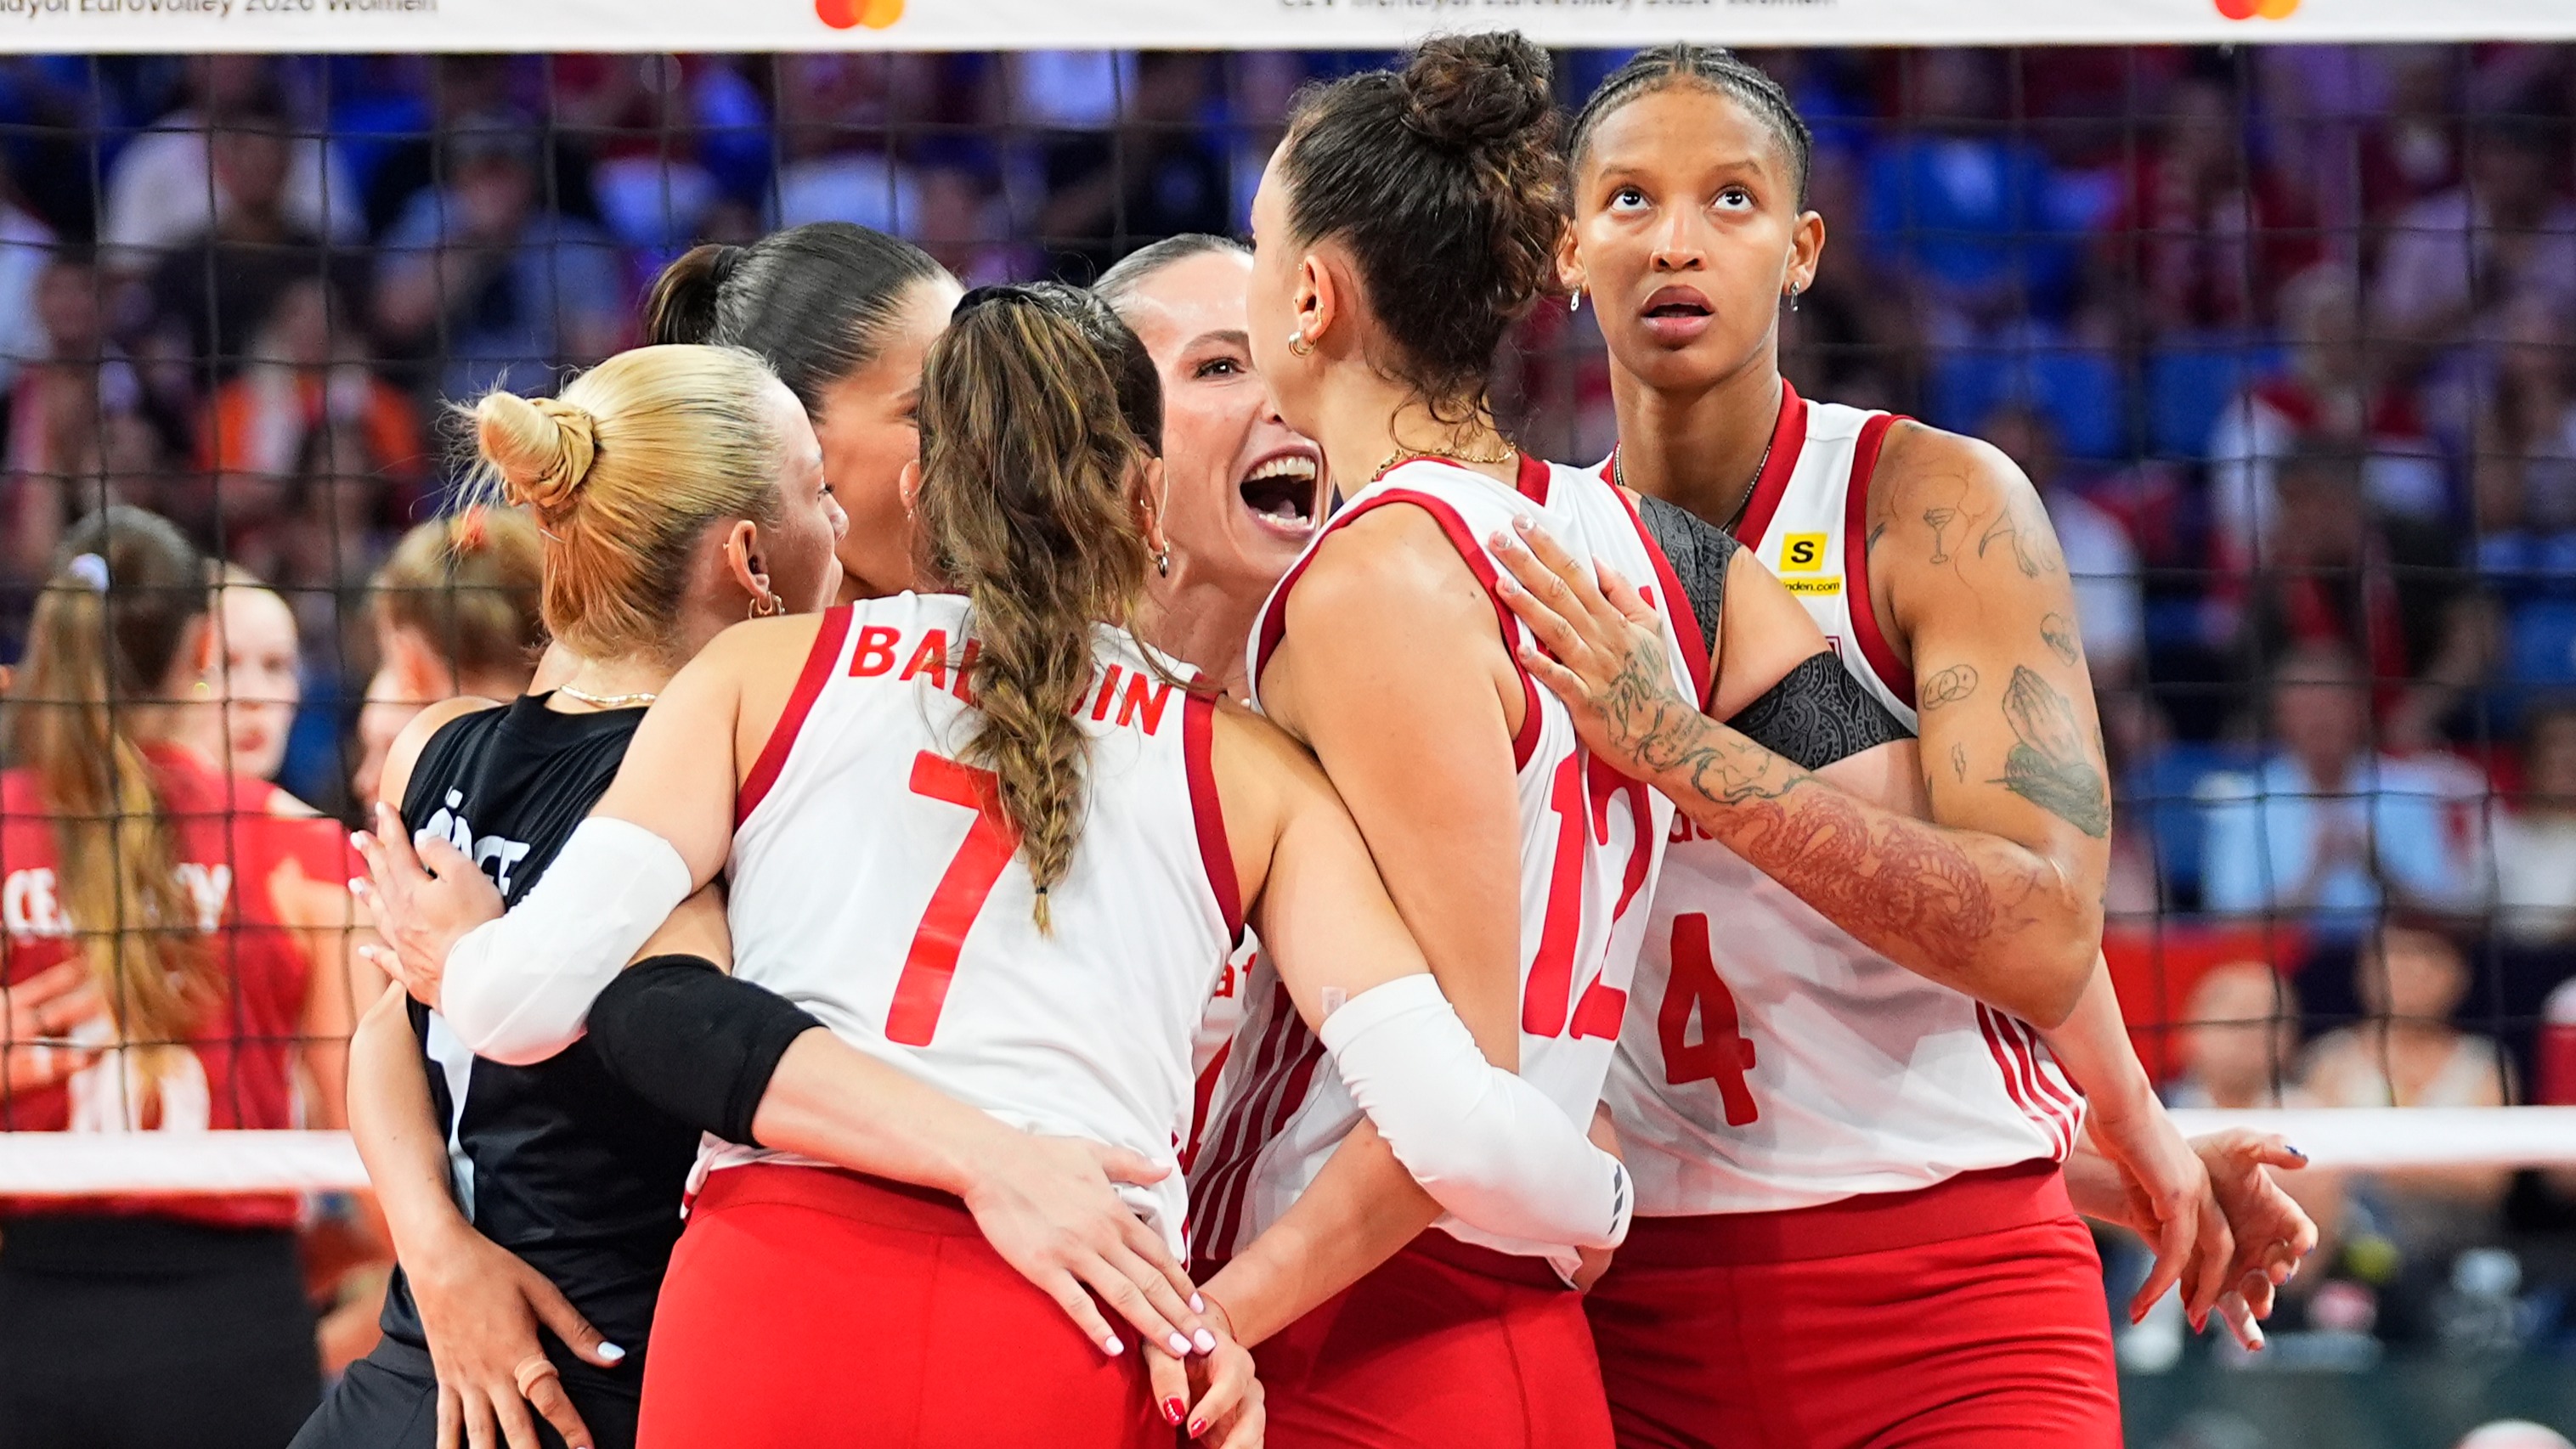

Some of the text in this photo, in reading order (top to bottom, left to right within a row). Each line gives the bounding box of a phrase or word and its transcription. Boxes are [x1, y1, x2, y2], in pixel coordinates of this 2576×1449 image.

[1790, 540, 1815, 564] S
[848, 624, 1173, 736] BALIN
[884, 749, 1025, 1047] 7
[1522, 750, 1653, 1040] 12
[1658, 912, 1759, 1127] 4
